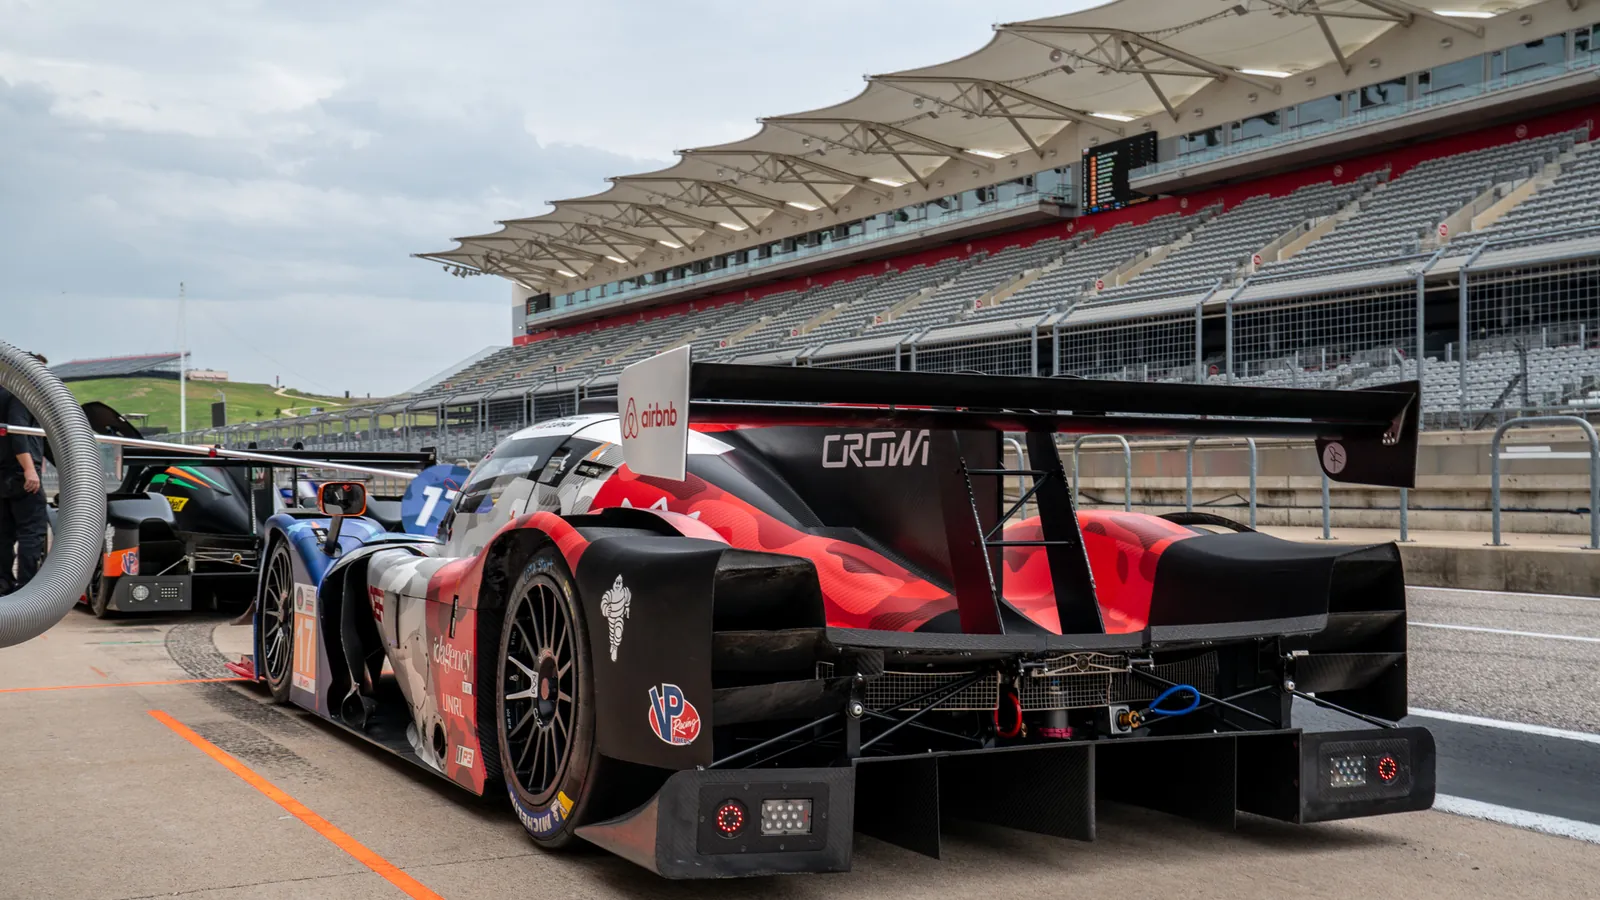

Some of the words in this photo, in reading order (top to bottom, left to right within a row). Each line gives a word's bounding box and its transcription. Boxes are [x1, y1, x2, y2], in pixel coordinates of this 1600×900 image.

[641, 401, 677, 428] airbnb
[297, 617, 313, 673] 17
[433, 635, 472, 681] idagency
[442, 693, 465, 718] UNRL
[649, 683, 685, 743] VP
[672, 717, 699, 735] Racing
